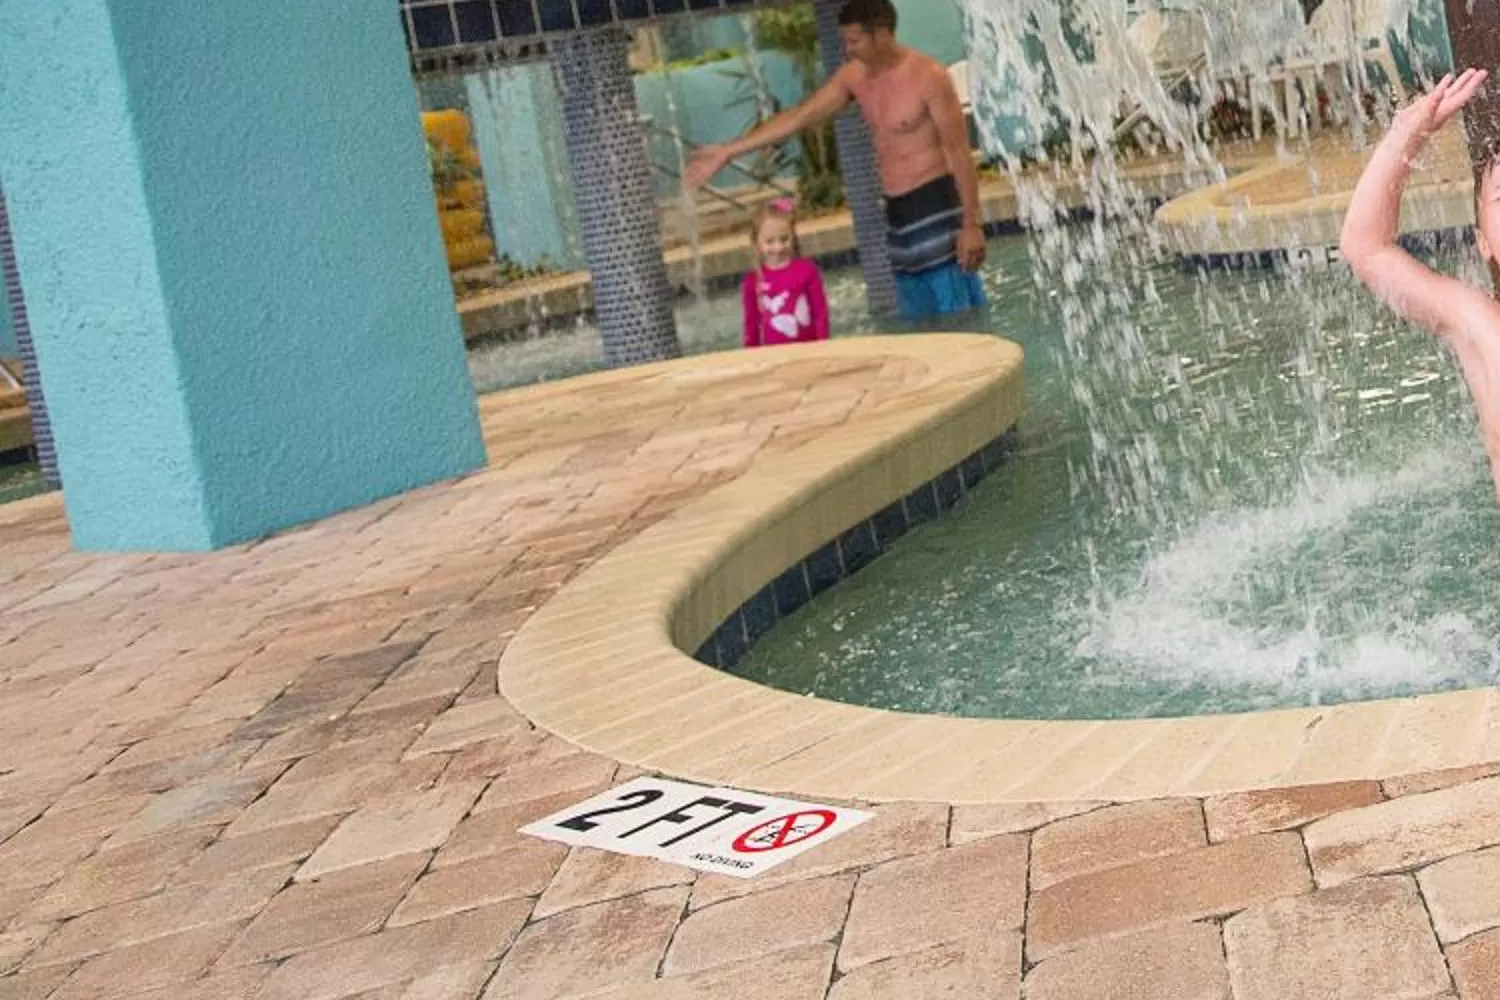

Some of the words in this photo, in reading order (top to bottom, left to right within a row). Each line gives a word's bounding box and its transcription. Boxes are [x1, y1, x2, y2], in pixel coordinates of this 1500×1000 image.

[554, 789, 664, 832] 2
[616, 796, 765, 848] FT
[690, 853, 713, 861] NO
[709, 855, 755, 869] DIVING
